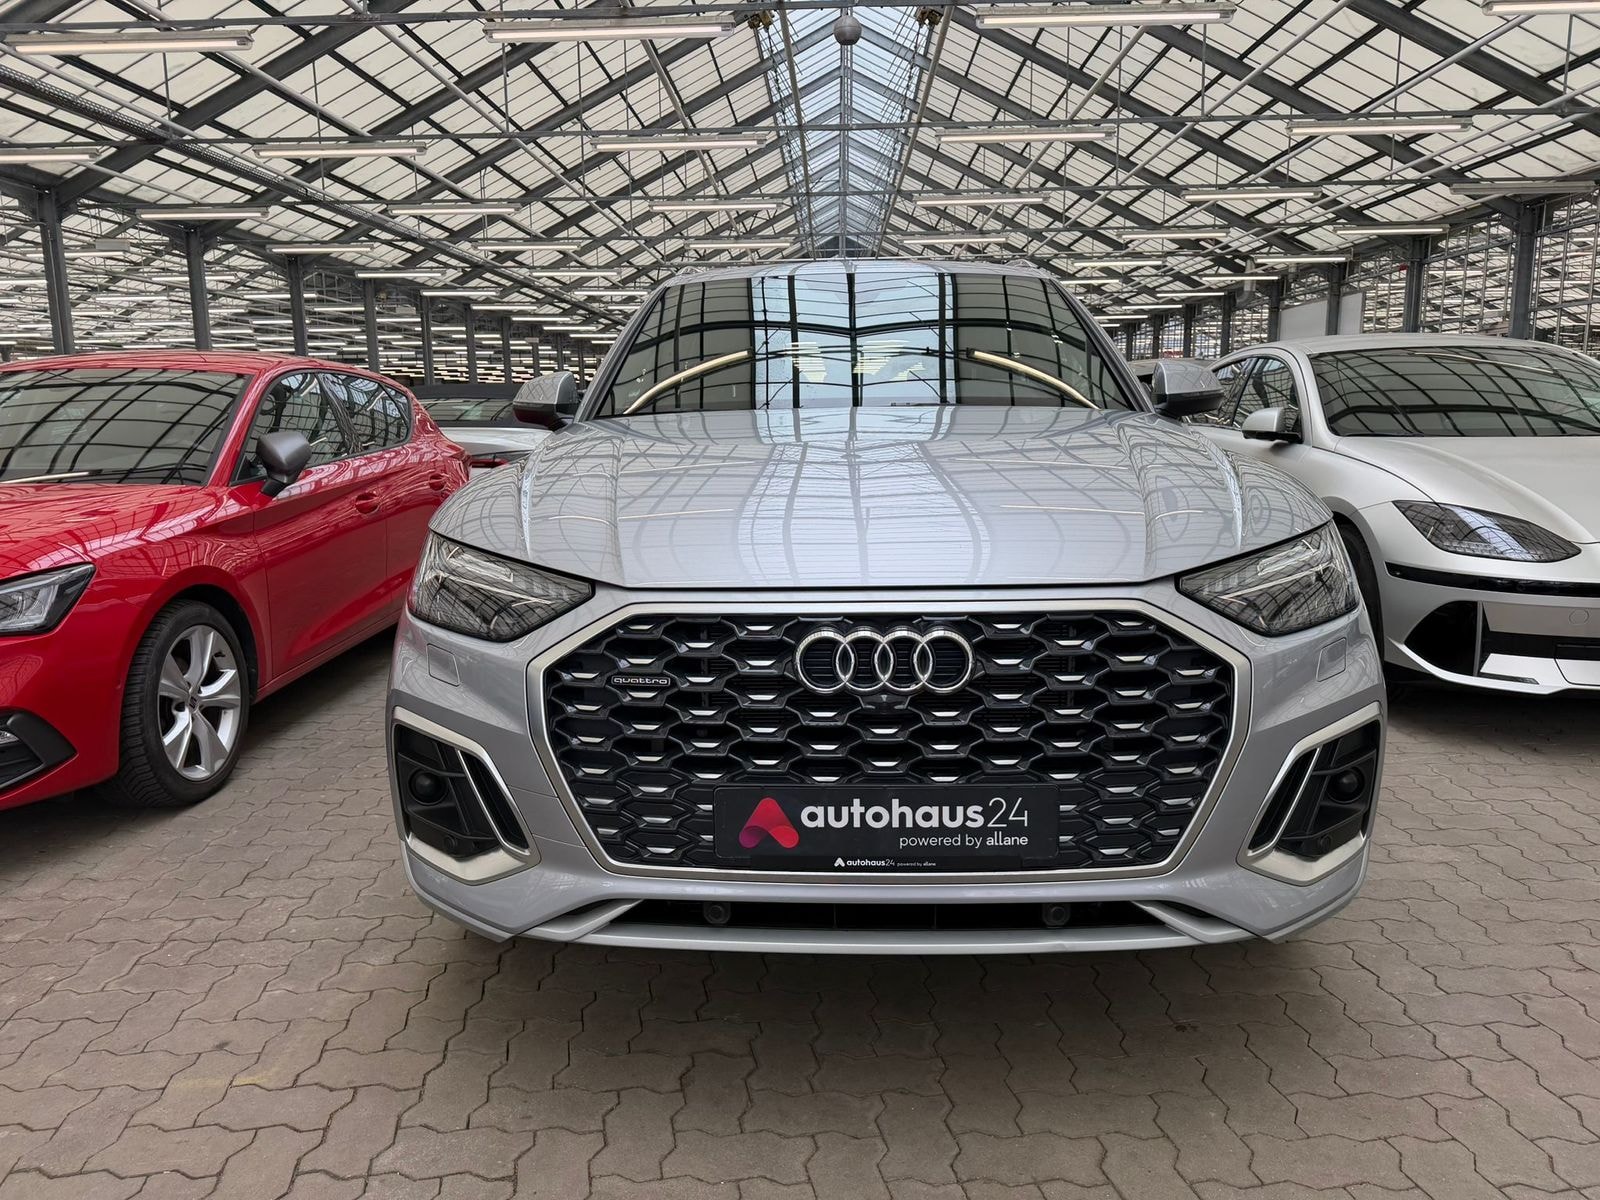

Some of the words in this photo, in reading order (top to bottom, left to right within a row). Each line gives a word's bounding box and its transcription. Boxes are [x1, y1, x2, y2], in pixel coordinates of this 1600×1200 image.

[800, 797, 1029, 828] autohaus24
[899, 834, 961, 849] powered
[965, 834, 983, 849] by
[986, 831, 1029, 847] allane
